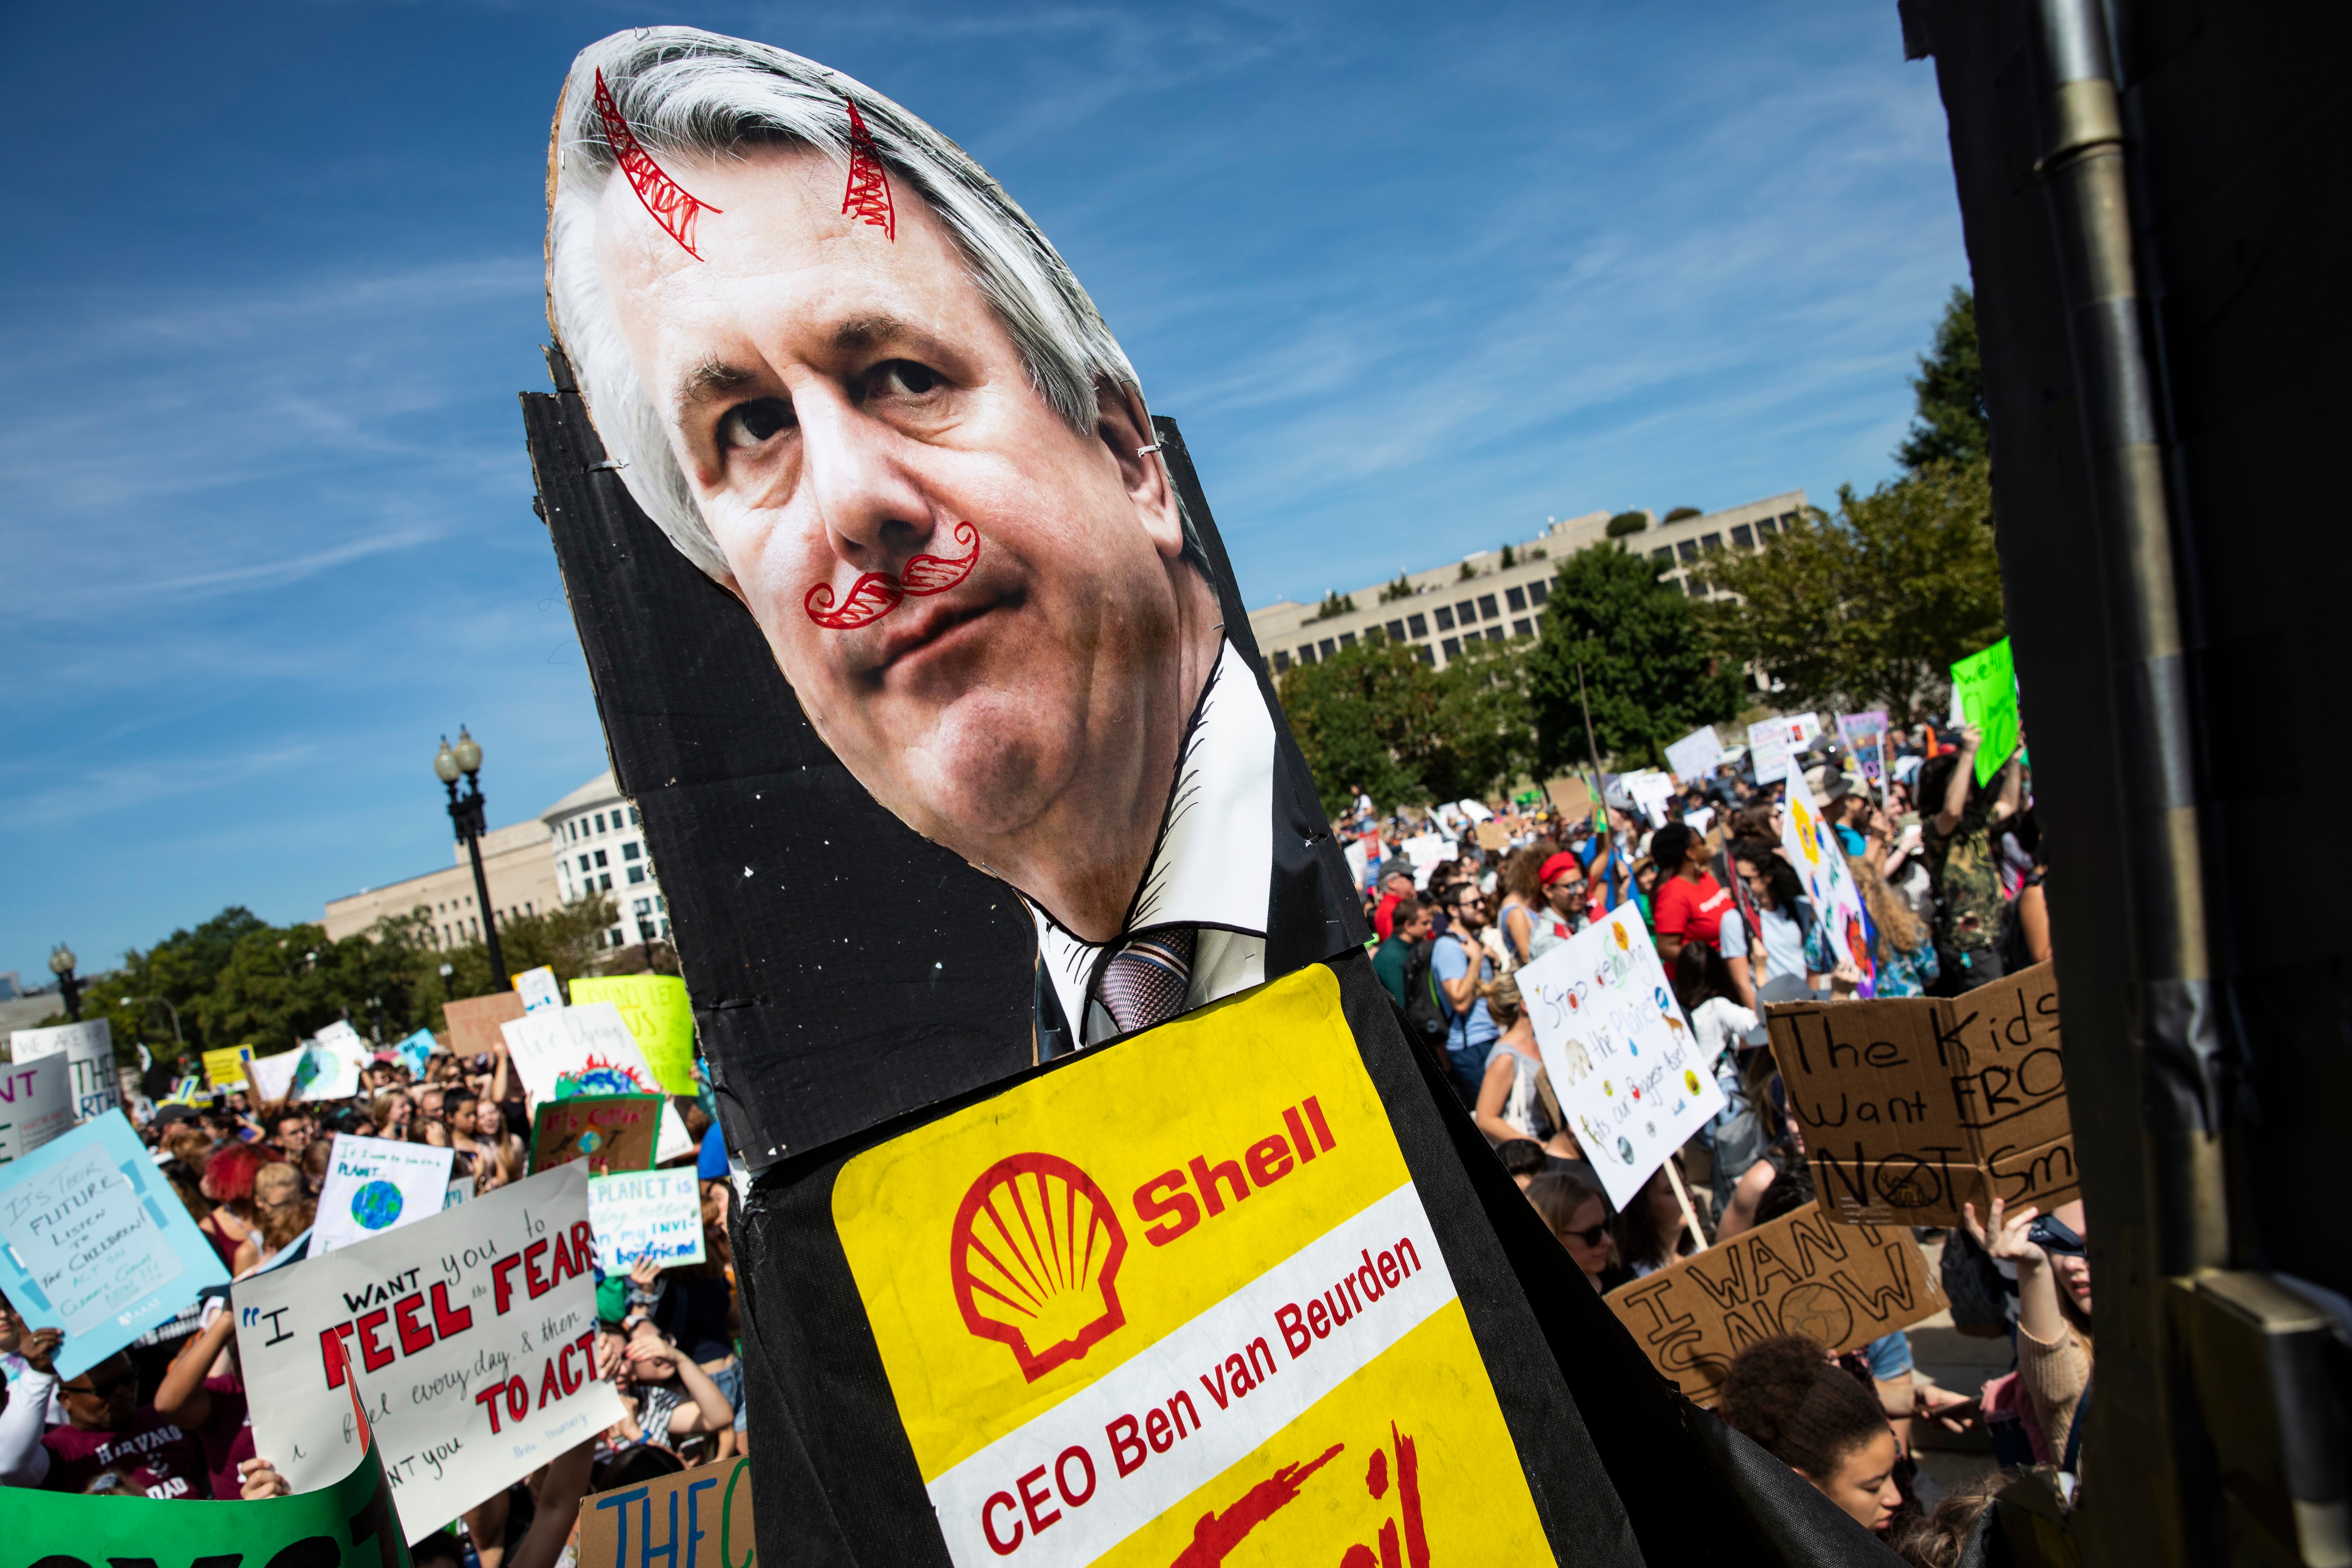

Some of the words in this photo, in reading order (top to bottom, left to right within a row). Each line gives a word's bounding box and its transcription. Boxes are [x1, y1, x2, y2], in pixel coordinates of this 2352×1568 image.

[648, 984, 674, 1006] LET
[1543, 980, 1590, 1029] Stop
[1587, 1030, 1618, 1065] the
[1766, 1010, 1909, 1074] The
[1929, 987, 2062, 1067] Kids
[1950, 1047, 2065, 1120] FRO
[599, 1178, 670, 1203] PLANET
[1132, 1095, 1337, 1247] Shell
[1817, 1141, 1962, 1213] NOT
[343, 1267, 420, 1313] WANT
[441, 1239, 497, 1286] you
[523, 1208, 546, 1238] to
[621, 1229, 646, 1247] my
[652, 1219, 695, 1234] INVI-
[319, 1280, 473, 1391] FEEL
[471, 1283, 488, 1299] the
[491, 1220, 594, 1316] FEAR
[1624, 1279, 1694, 1345] I
[343, 1392, 391, 1444] fel
[412, 1368, 470, 1405] every
[521, 1331, 534, 1354] &
[541, 1310, 581, 1343] then
[475, 1374, 529, 1435] TO
[982, 1445, 1096, 1556] CEO
[1105, 1389, 1202, 1479] Ben
[1199, 1336, 1278, 1411] van
[1274, 1237, 1422, 1360] Beurden
[95, 1425, 183, 1465] HARVARD
